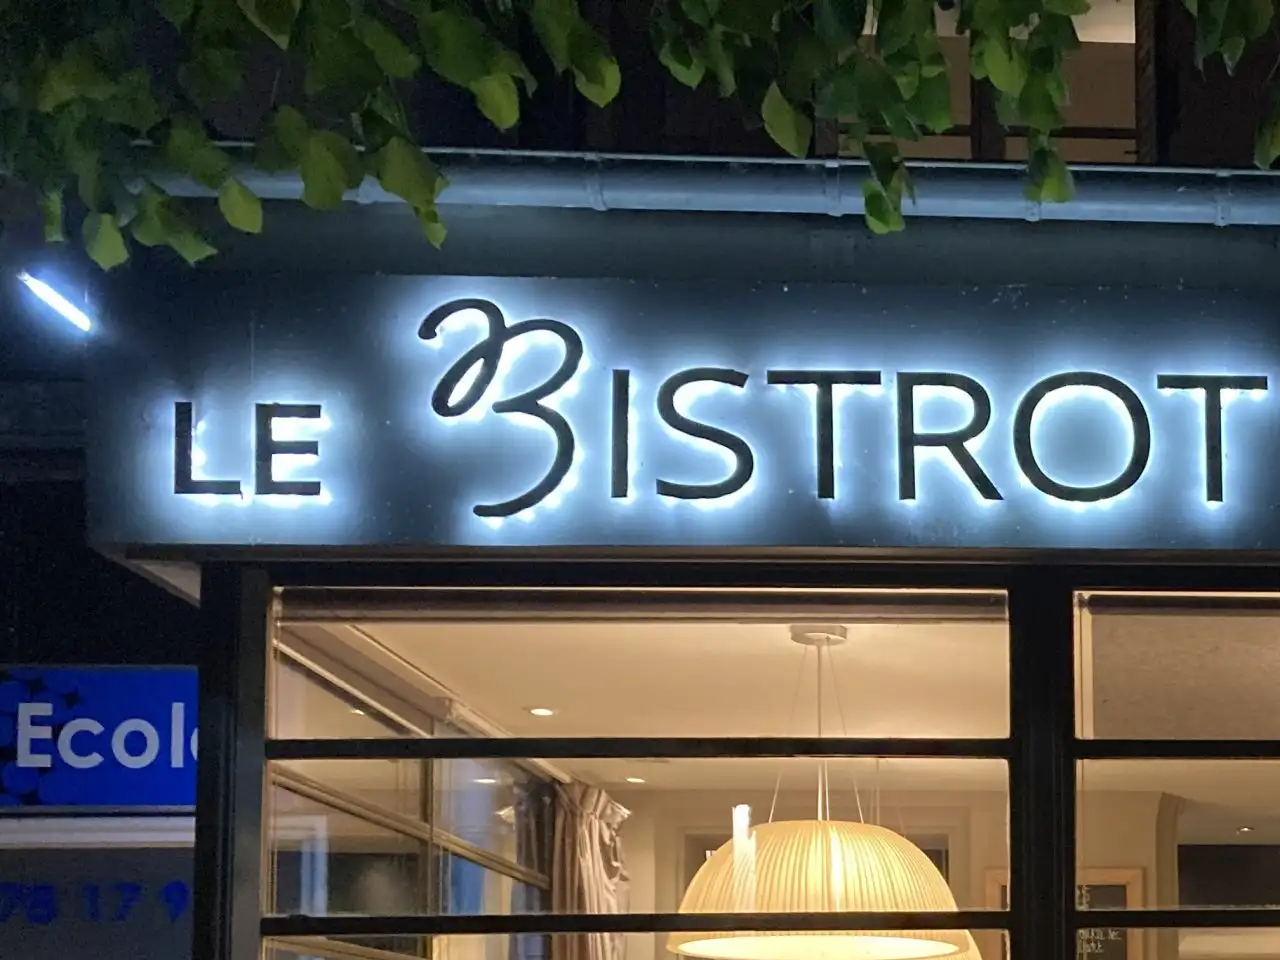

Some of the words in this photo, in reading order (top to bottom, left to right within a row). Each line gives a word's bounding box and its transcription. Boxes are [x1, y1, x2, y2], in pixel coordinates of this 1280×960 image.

[174, 401, 322, 496] LE
[418, 298, 1268, 516] BISTROT
[17, 702, 198, 768] Ecol
